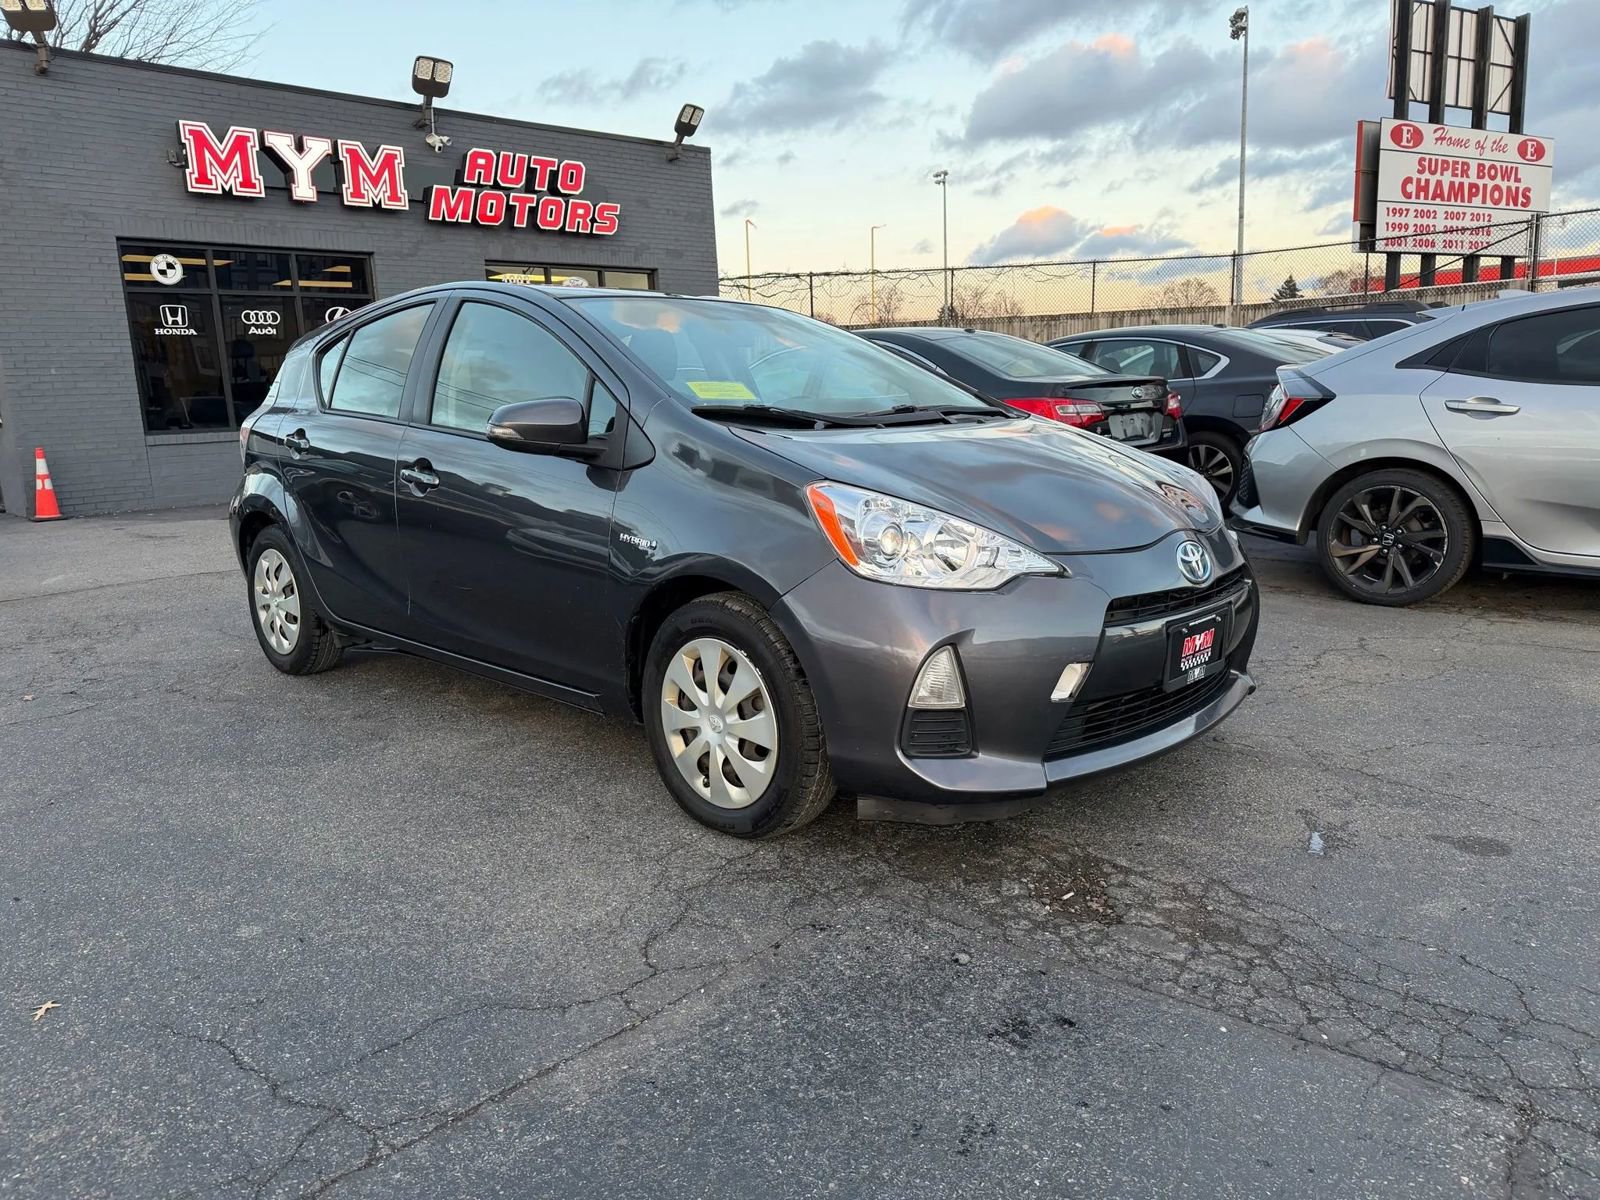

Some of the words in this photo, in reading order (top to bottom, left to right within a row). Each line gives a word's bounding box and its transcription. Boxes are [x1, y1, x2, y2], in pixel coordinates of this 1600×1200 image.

[1401, 126, 1413, 146] E
[1433, 126, 1470, 149] Home
[1475, 135, 1487, 156] of
[1490, 136, 1509, 154] the
[1525, 141, 1536, 159] E
[178, 119, 410, 211] MYM
[463, 147, 586, 195] AUTO
[1417, 157, 1470, 178] SUPER
[1477, 163, 1521, 183] BOWL
[1401, 177, 1531, 208] CHAMPIONS
[428, 184, 621, 236] MOTORS
[1385, 207, 1410, 218] 1997
[1413, 208, 1437, 220] 2002
[1443, 210, 1467, 221] 2007
[1470, 212, 1492, 223] 2012
[1385, 222, 1409, 233] 1999
[1413, 223, 1437, 234] 2003
[1442, 240, 1465, 250] 2011
[248, 326, 276, 335] Audi
[620, 533, 651, 547] HYBRID
[1182, 627, 1215, 657] MYM
